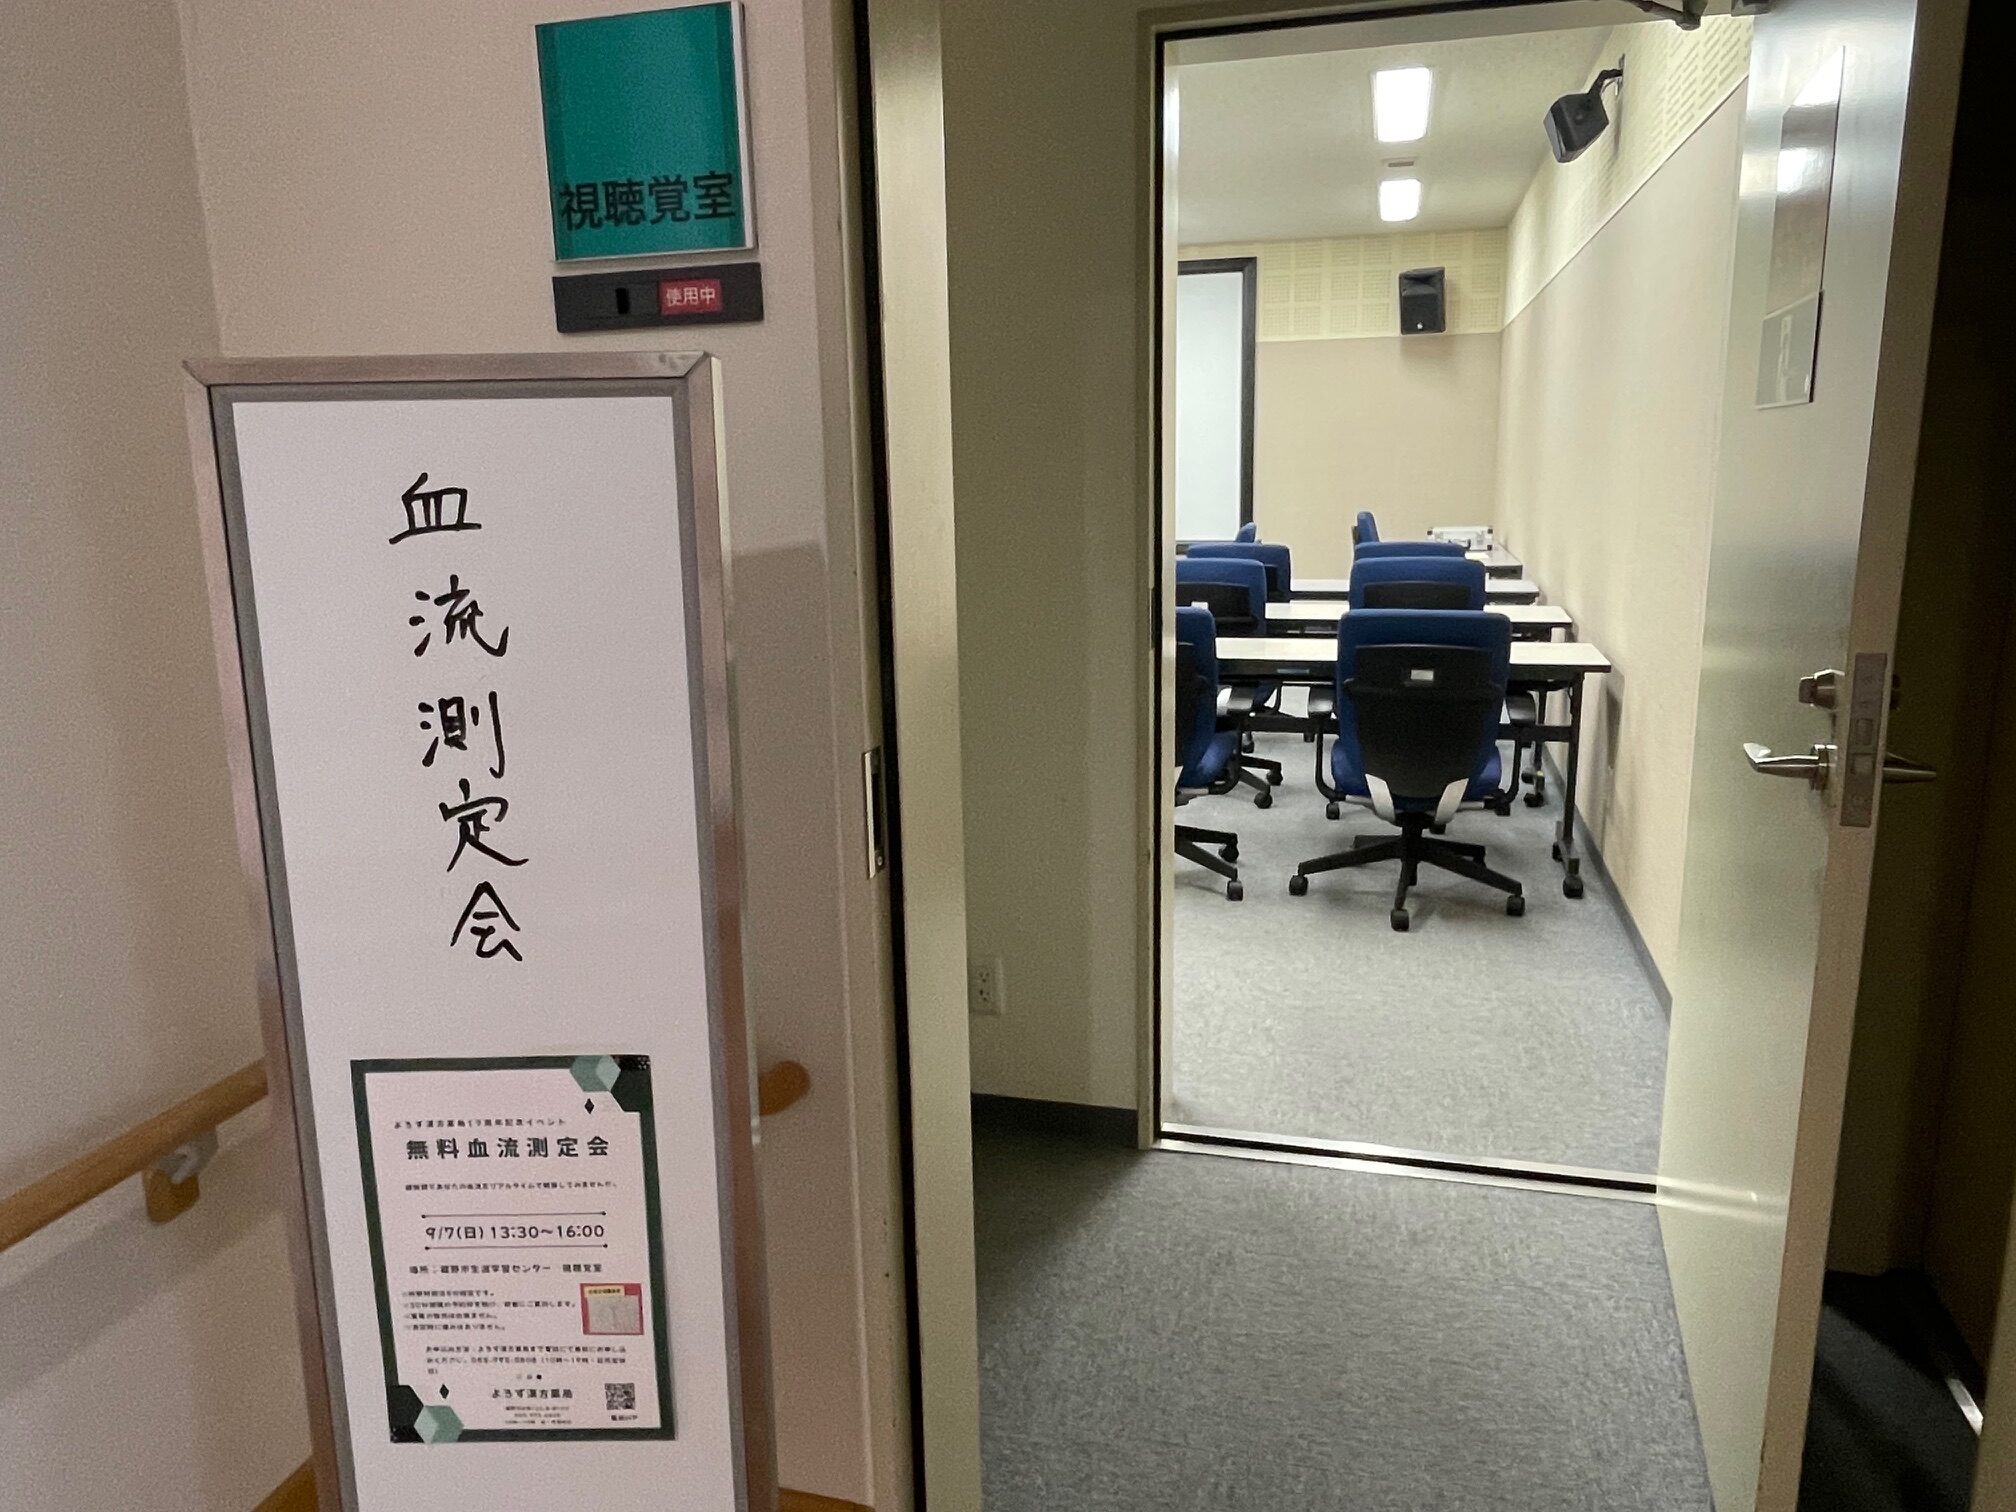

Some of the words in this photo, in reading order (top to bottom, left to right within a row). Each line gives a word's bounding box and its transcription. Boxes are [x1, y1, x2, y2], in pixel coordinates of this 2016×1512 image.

[558, 171, 736, 231] 視聴覚室
[665, 285, 717, 306] 使用中
[388, 472, 530, 962] 血流測定会
[406, 1135, 610, 1160] 無料血流測定会
[425, 1225, 484, 1240] 9/7(日)
